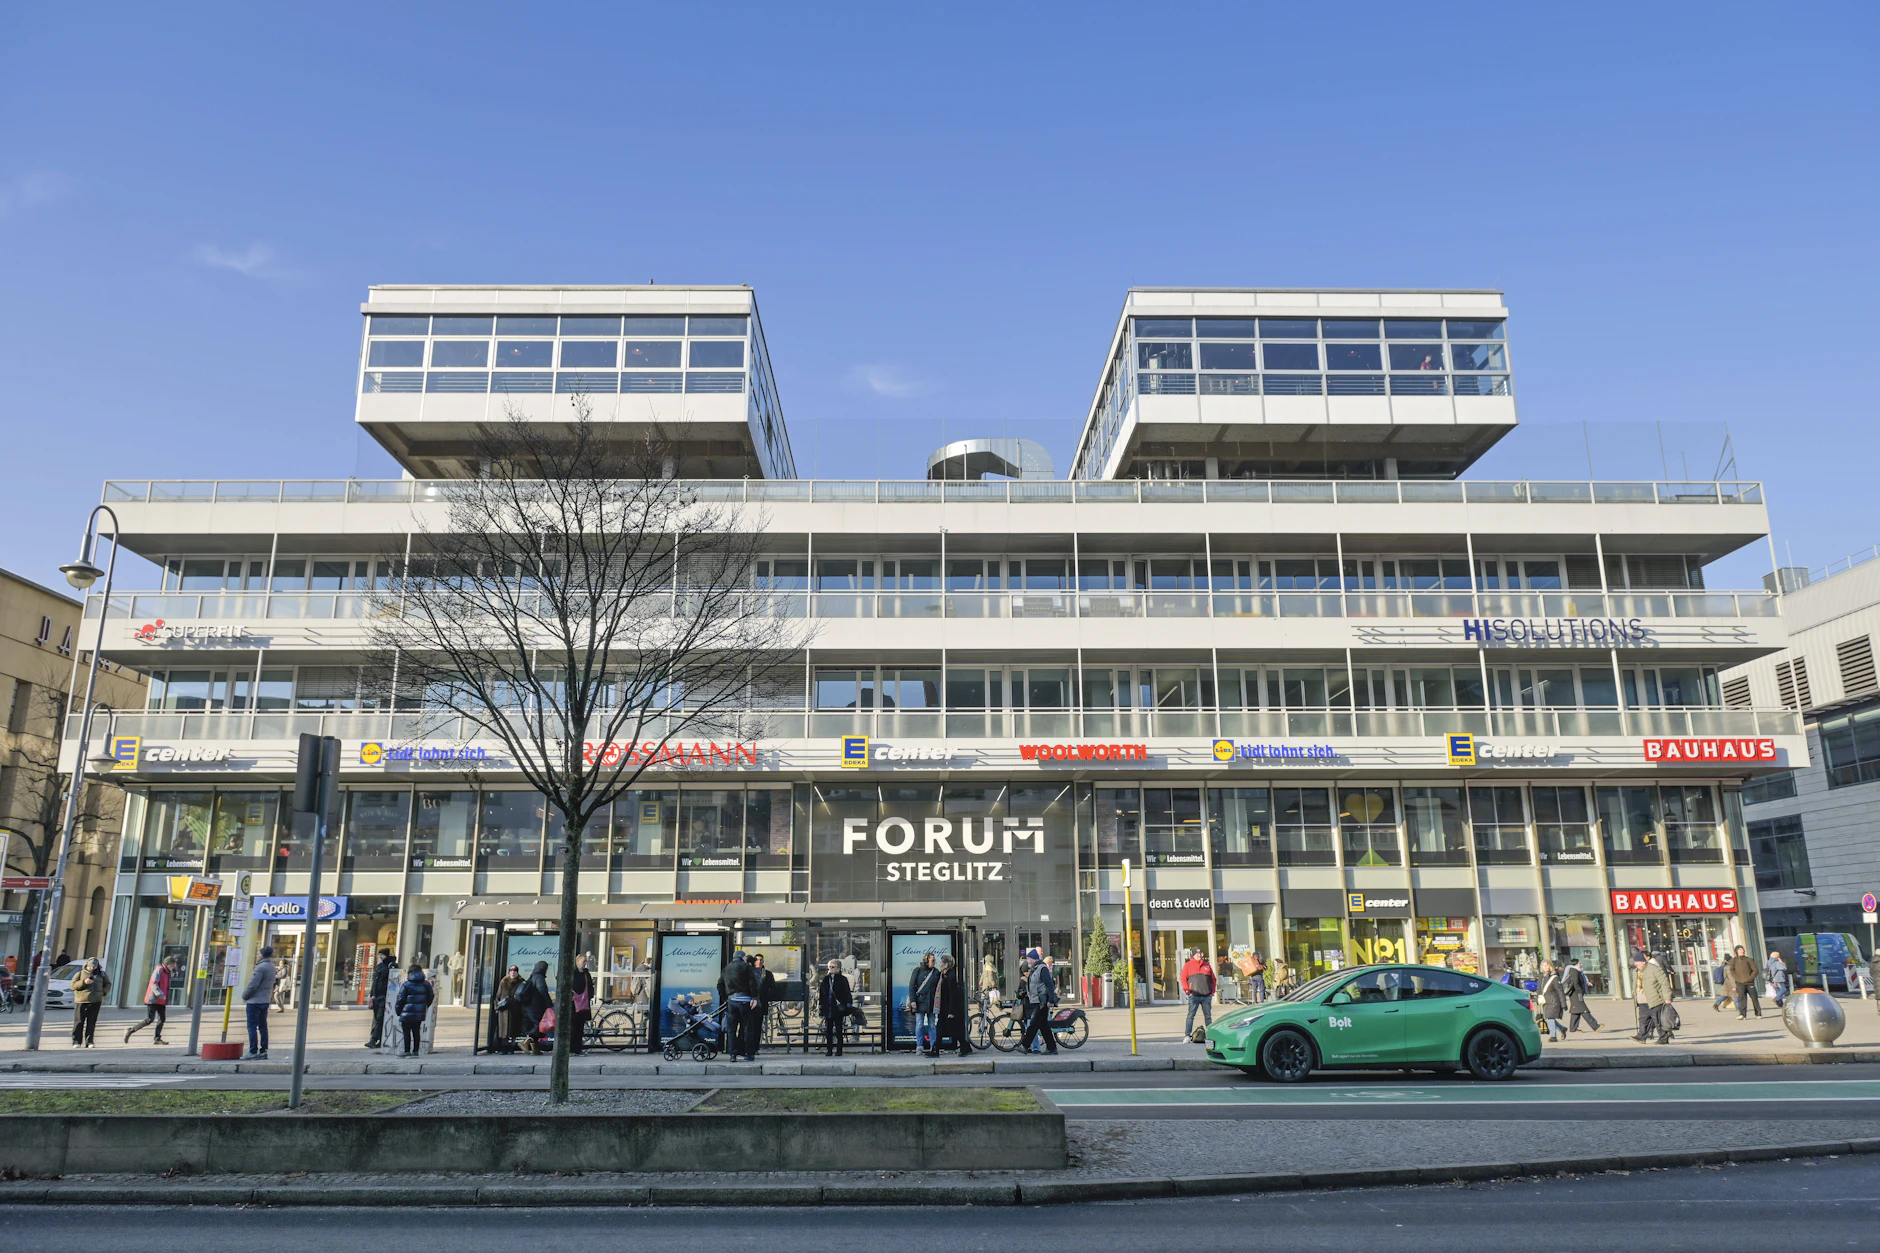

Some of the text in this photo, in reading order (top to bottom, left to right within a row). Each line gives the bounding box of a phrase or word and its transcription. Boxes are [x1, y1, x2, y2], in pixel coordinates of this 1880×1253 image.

[161, 625, 245, 638] SUPERFIT
[1463, 618, 1646, 641] HISOLUTIONS
[145, 746, 232, 762] center
[388, 746, 489, 760] Lidl lohnt sich.
[874, 746, 959, 761] center
[1019, 744, 1147, 761] WOOLWORTH
[1240, 744, 1338, 758] Lidl lohnt sich.
[1479, 743, 1561, 758] center
[1647, 741, 1775, 759] BAUHAUS
[843, 816, 1045, 855] FORUM
[681, 858, 740, 866] Wir Lebensmittel.
[1146, 855, 1205, 863] Wir Lebensmittel.
[1557, 851, 1594, 860] Lebensmittel.
[145, 859, 157, 868] Wir
[412, 859, 472, 867] Wir Lebensmittel.
[887, 862, 1003, 881] STEGLITZ
[1149, 897, 1210, 909] dean & david
[1365, 899, 1409, 908] center
[1615, 893, 1735, 910] BAUHAUS
[259, 901, 300, 917] Apollo
[511, 947, 537, 956] Mein
[665, 947, 718, 958] Mein Schiff
[895, 946, 922, 956] Mein
[1328, 1016, 1352, 1030] Bolt
